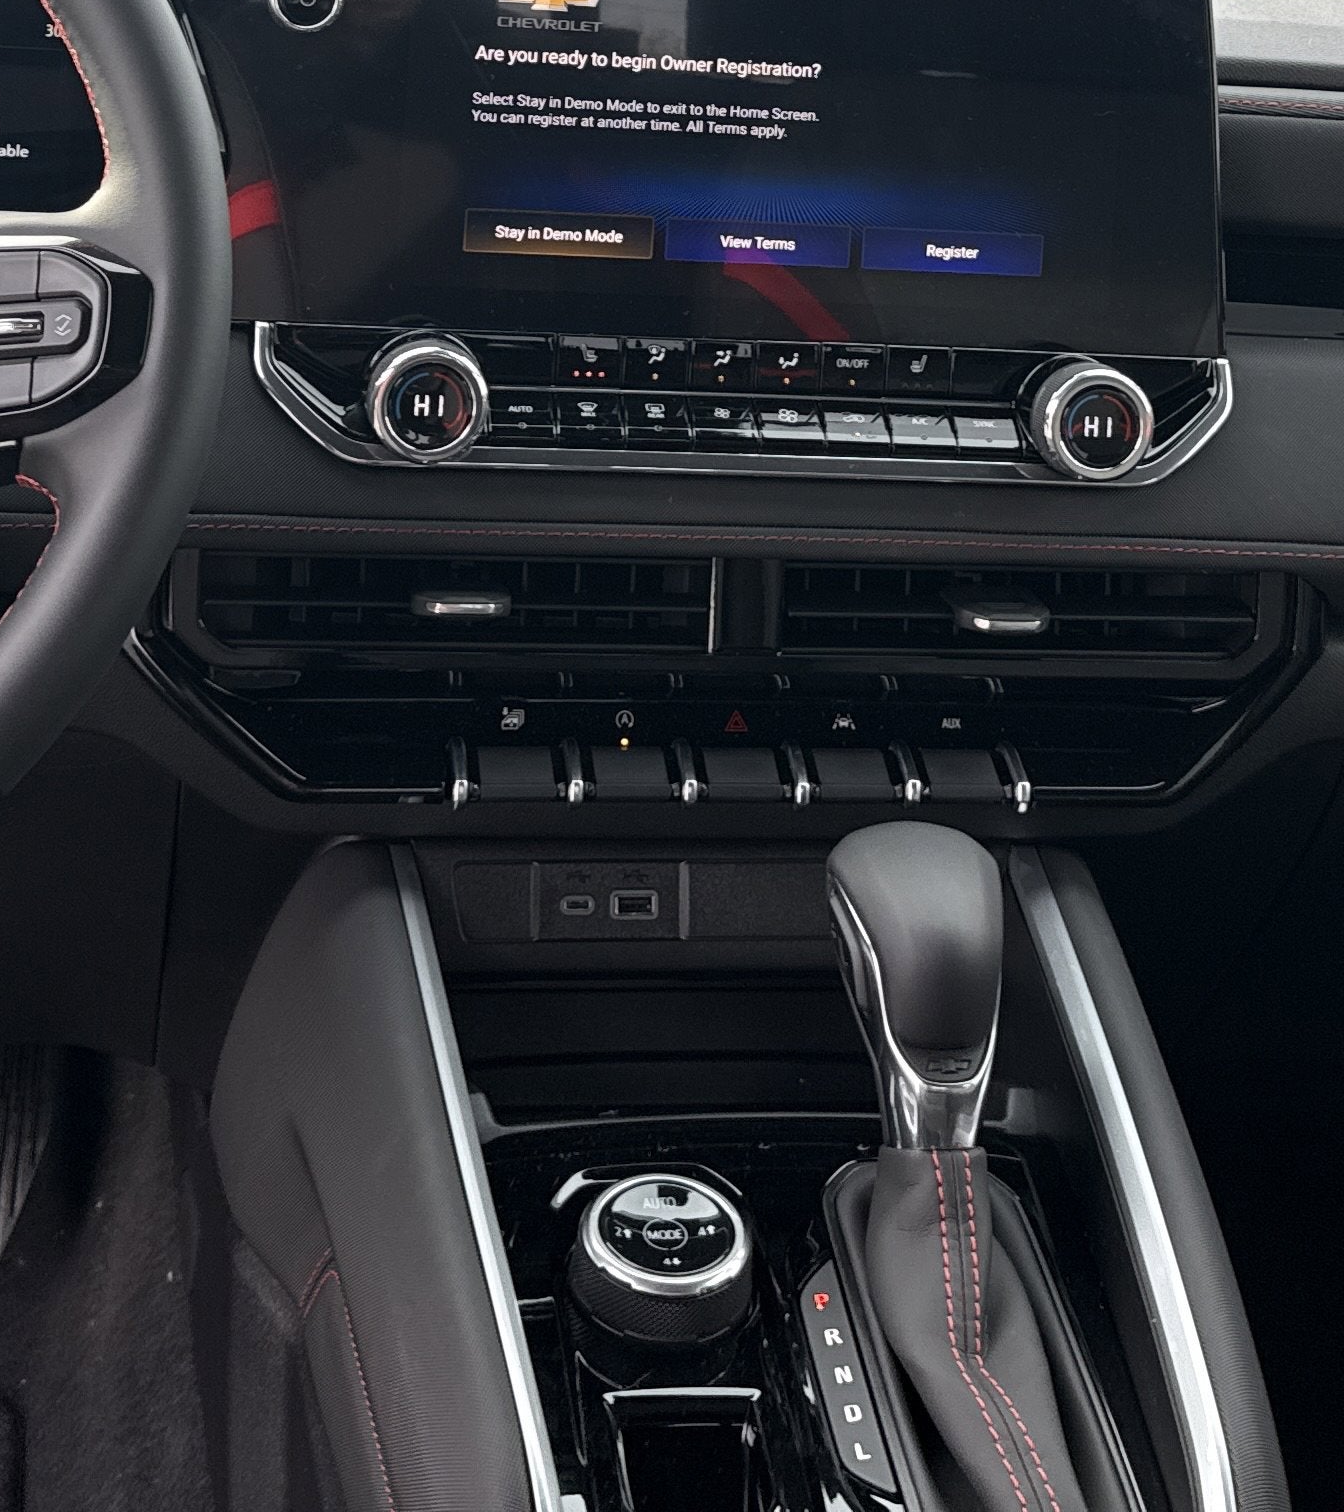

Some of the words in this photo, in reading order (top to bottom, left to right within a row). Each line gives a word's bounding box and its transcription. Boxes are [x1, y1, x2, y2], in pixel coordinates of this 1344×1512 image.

[497, 16, 604, 33] CHEVROLET
[474, 44, 505, 62] Are
[508, 50, 538, 66] you
[542, 49, 588, 69] ready
[591, 53, 607, 67] to
[612, 52, 657, 74] begin
[661, 55, 713, 73] Owner
[717, 58, 821, 79] Registration?
[472, 91, 514, 107] Select
[517, 94, 546, 110] Stay
[549, 96, 561, 109] in
[565, 96, 603, 112] Demo
[606, 98, 644, 113] Mode
[647, 101, 660, 114] to
[663, 101, 687, 115] exit
[690, 103, 703, 116] to
[706, 103, 727, 118] the
[729, 105, 769, 119] Home
[772, 107, 820, 122] Screen.
[471, 109, 497, 123] You
[500, 112, 525, 124] can
[528, 112, 577, 128] register
[580, 116, 594, 128] at
[597, 116, 647, 131] another
[650, 118, 683, 133] time.
[686, 120, 703, 134] All
[707, 121, 747, 136] Terms
[750, 123, 788, 140] apply.
[494, 224, 525, 242] Stay
[527, 226, 540, 241] in
[543, 227, 582, 243] Demo
[586, 228, 624, 244] Mode
[720, 235, 751, 249] View
[755, 236, 795, 251] Terms
[925, 244, 979, 261] Register
[836, 358, 870, 369] ON/OFF
[413, 394, 444, 417] HI
[508, 404, 534, 413] AUTO
[1083, 415, 1113, 438] HI
[941, 717, 962, 729] AUX
[642, 1196, 677, 1208] AUTO
[646, 1228, 684, 1240] MODE
[813, 1292, 829, 1310] P
[824, 1328, 843, 1346] R
[834, 1365, 853, 1384] N
[843, 1404, 862, 1422] D
[854, 1442, 872, 1460] L
